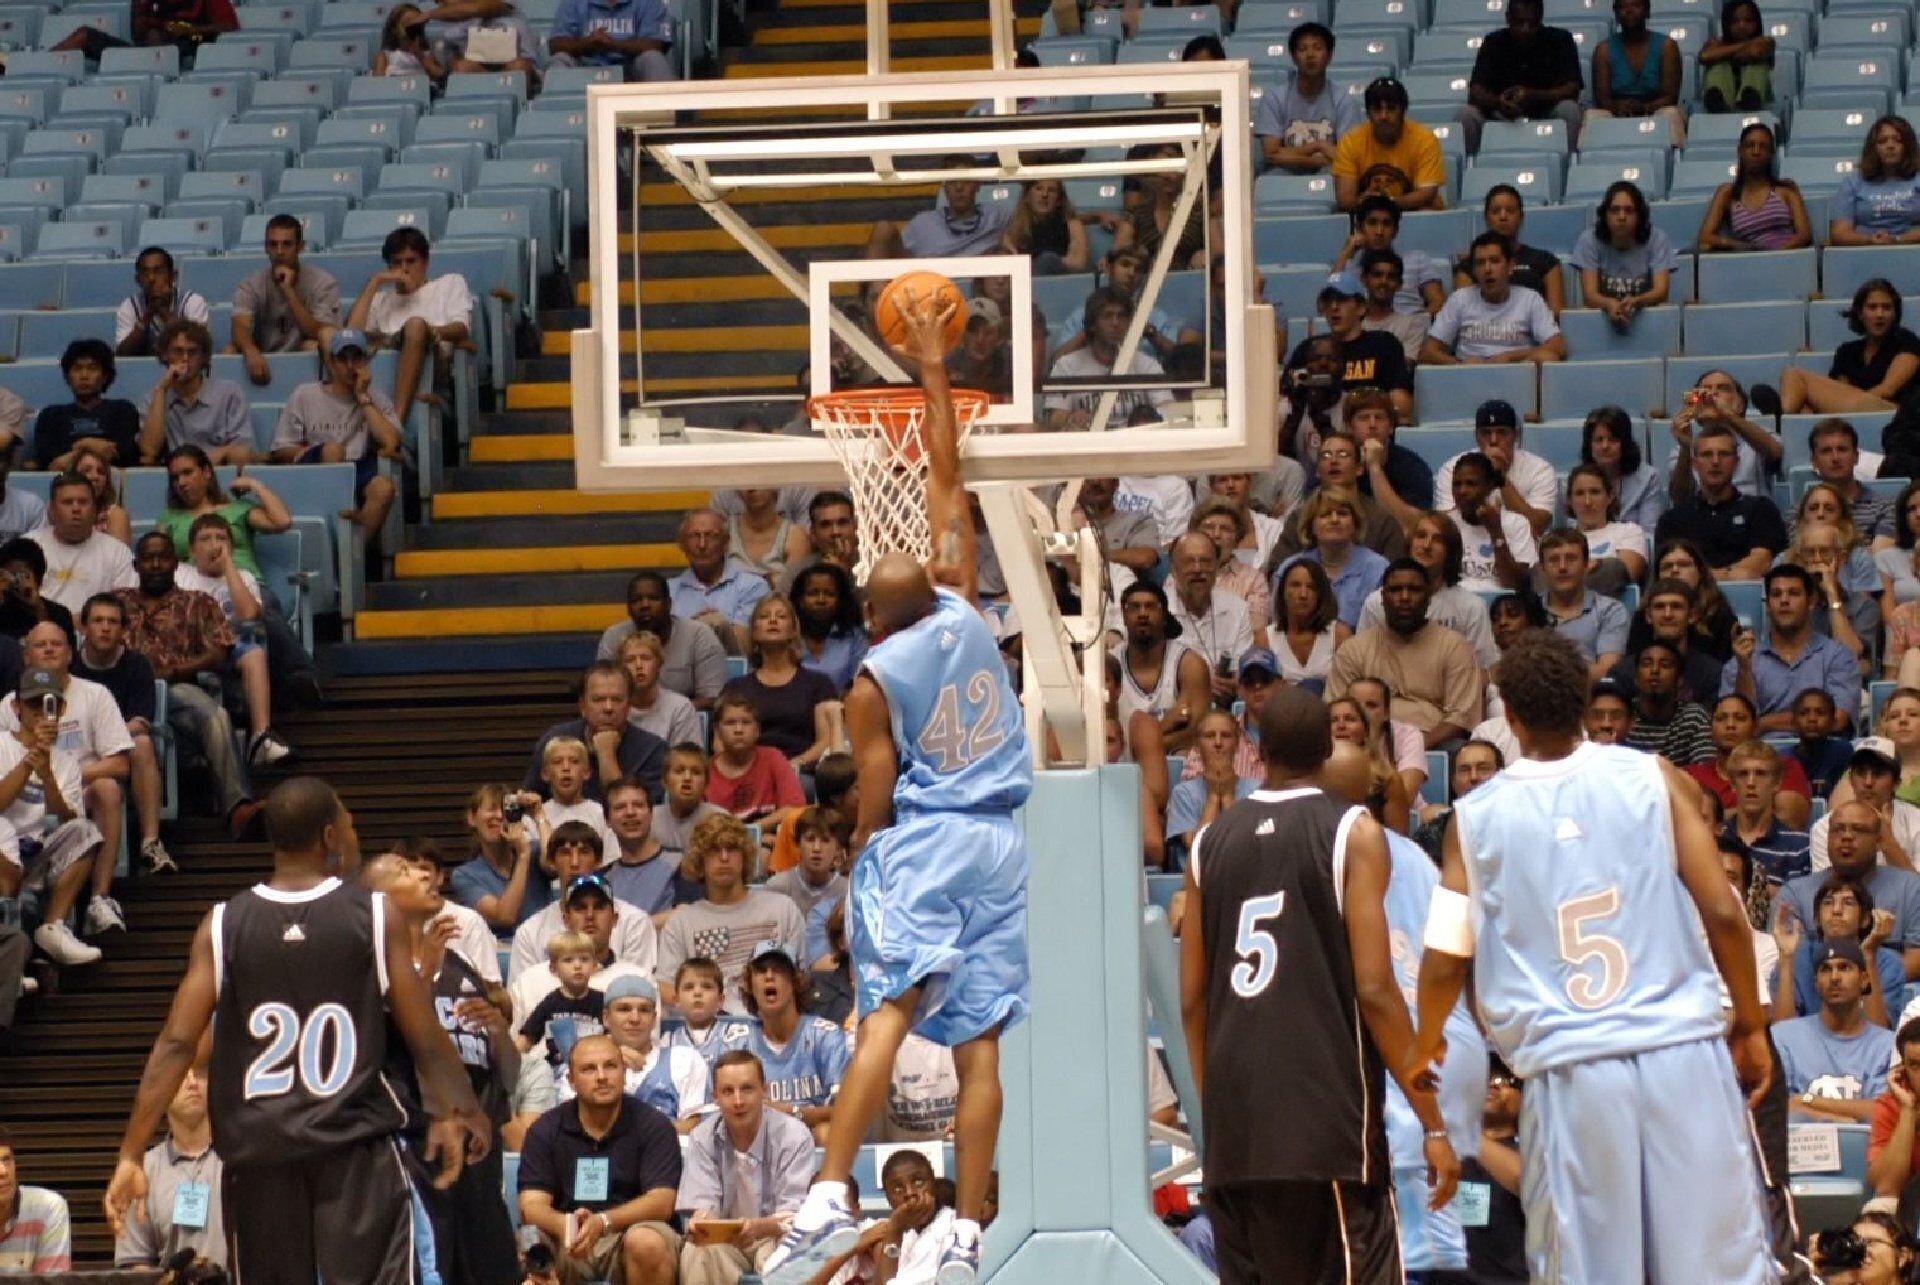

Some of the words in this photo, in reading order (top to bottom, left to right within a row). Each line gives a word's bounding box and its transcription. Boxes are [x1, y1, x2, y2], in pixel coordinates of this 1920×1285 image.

[918, 669, 1005, 772] 42
[1231, 890, 1285, 998] 5
[1557, 887, 1629, 1009] 5
[243, 1001, 358, 1101] 20
